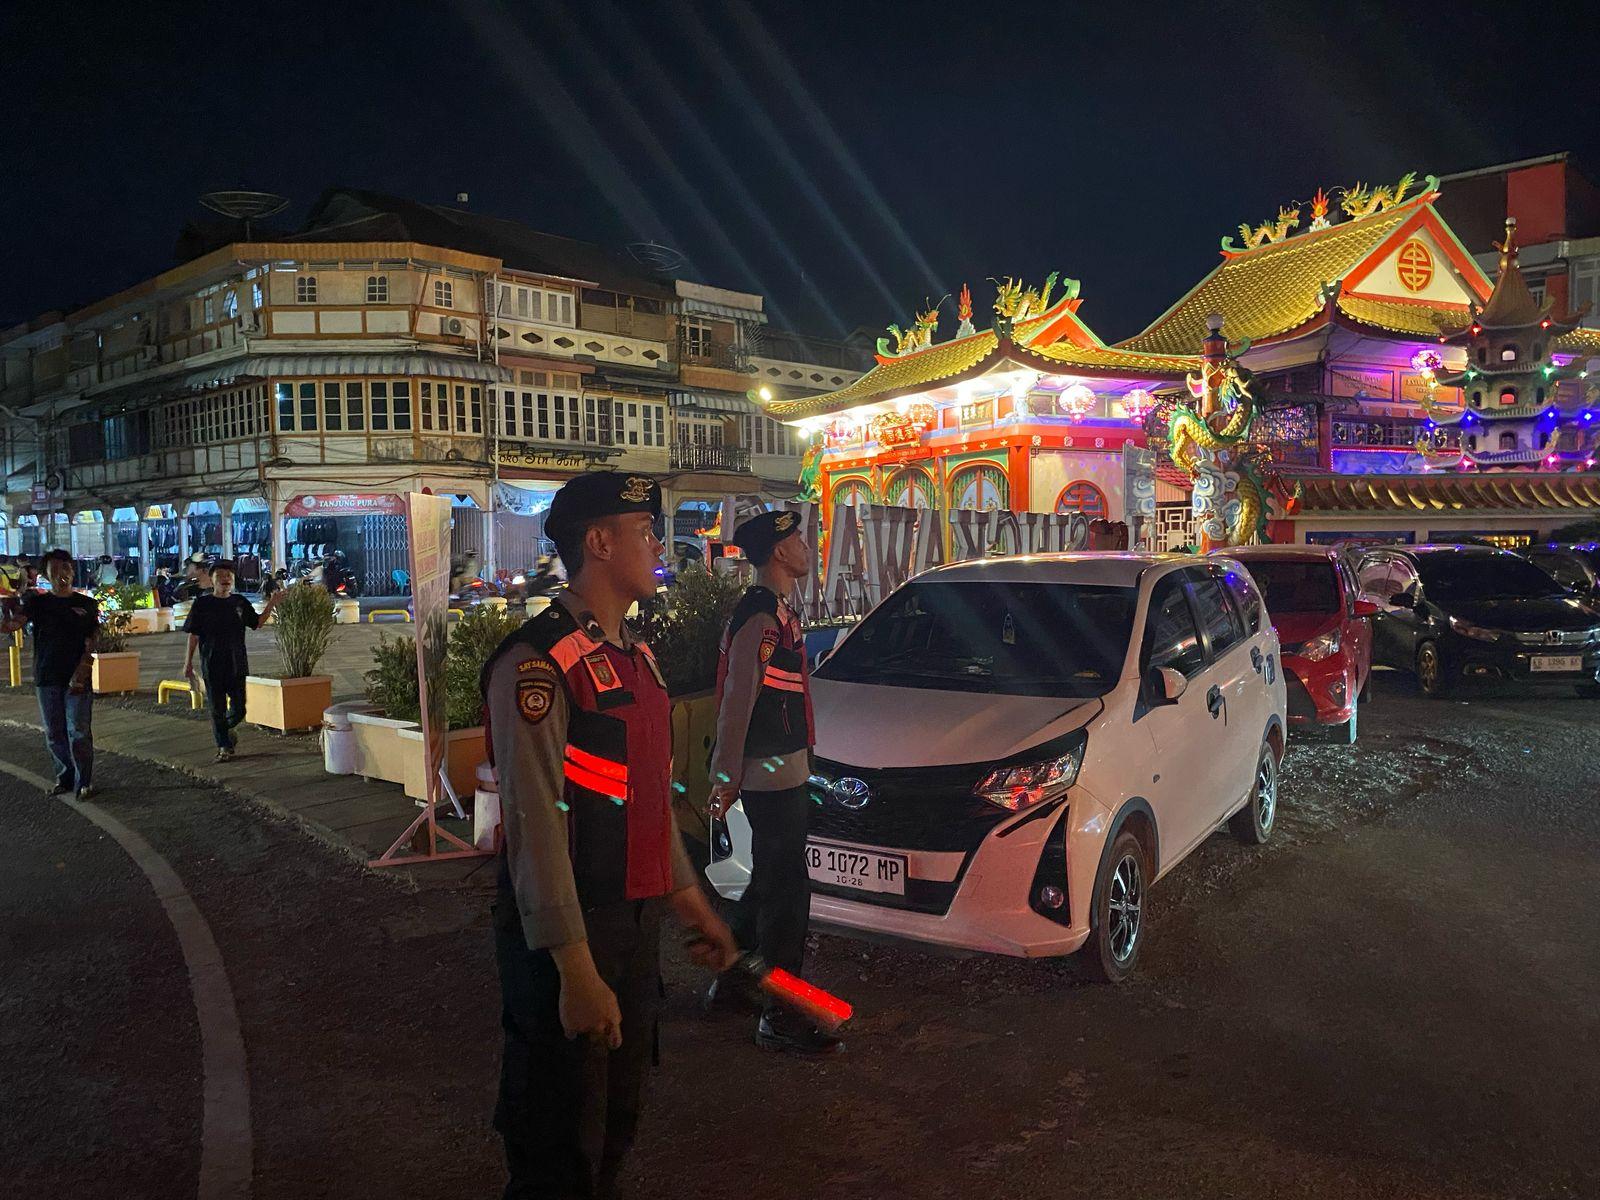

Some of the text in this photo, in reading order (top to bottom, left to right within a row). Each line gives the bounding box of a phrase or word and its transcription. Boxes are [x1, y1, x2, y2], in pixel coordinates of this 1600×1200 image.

[319, 499, 356, 508] TANJUNG
[357, 499, 378, 507] PURA
[827, 850, 869, 877] 1072
[877, 858, 900, 882] MP
